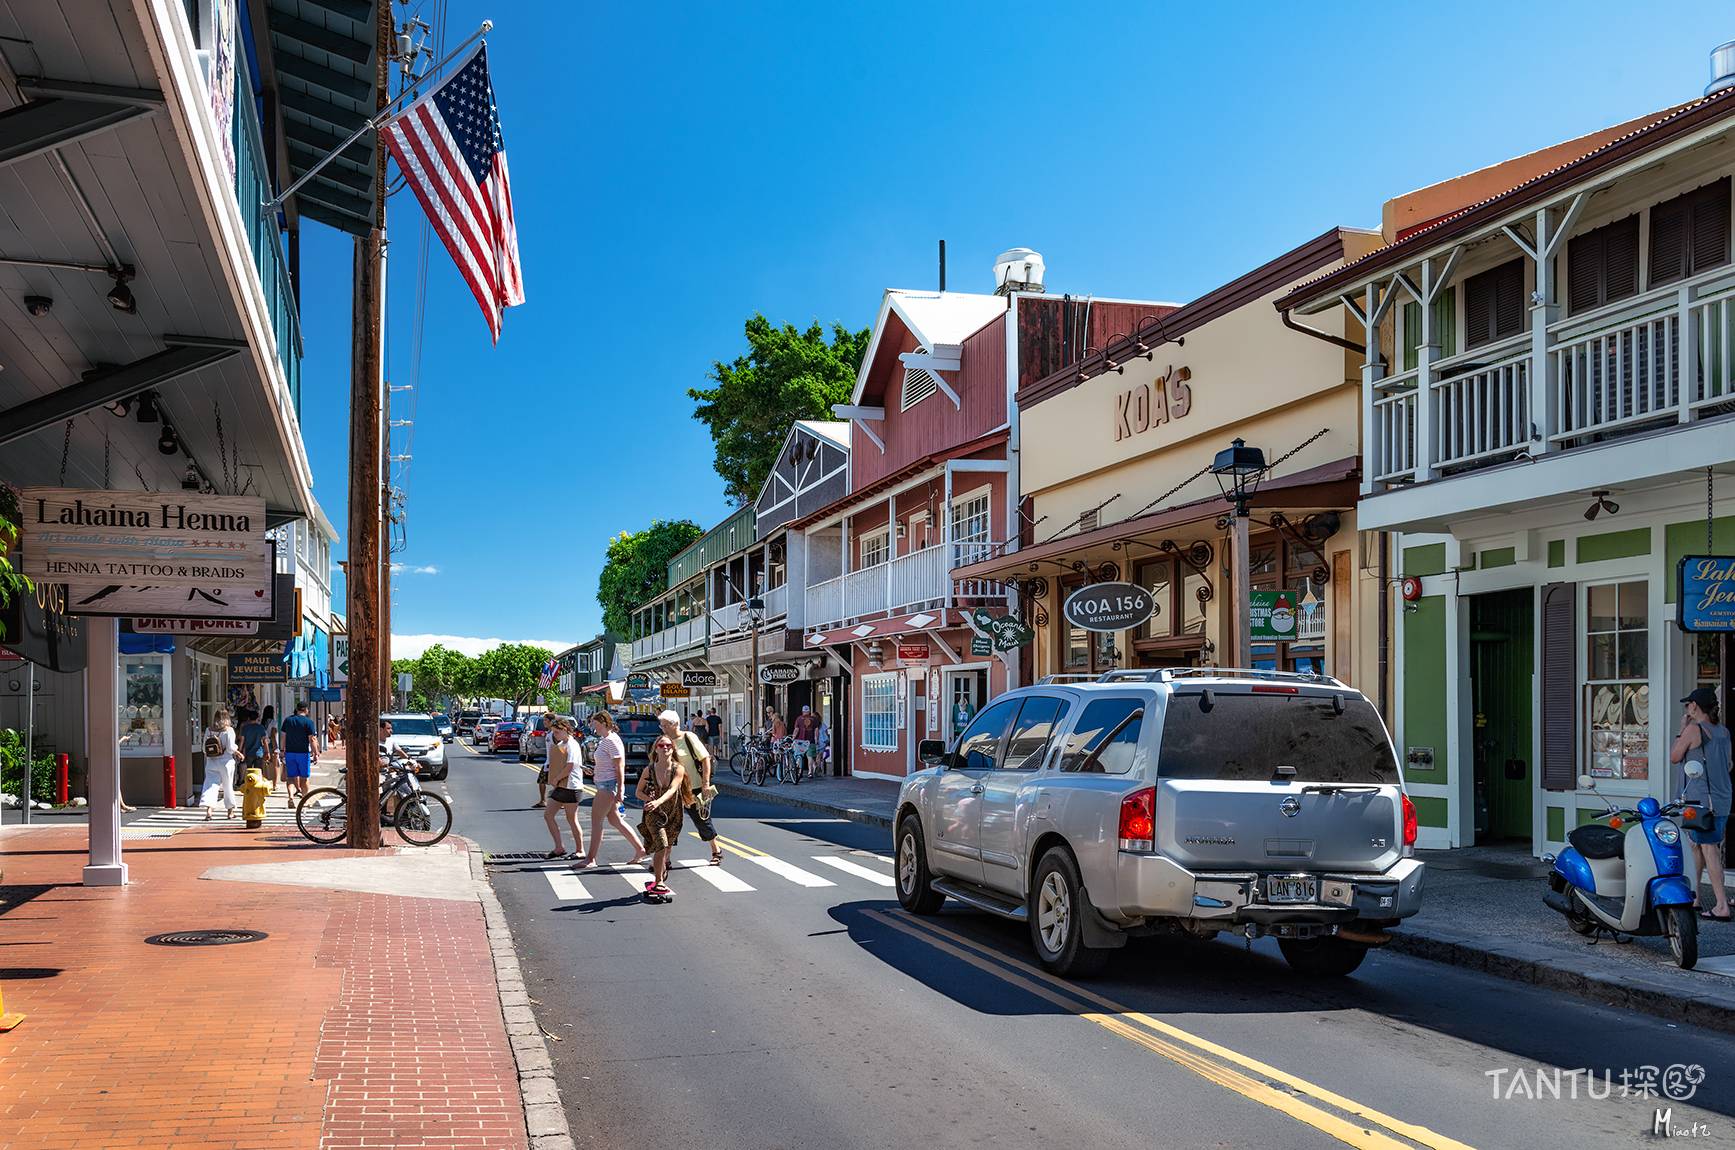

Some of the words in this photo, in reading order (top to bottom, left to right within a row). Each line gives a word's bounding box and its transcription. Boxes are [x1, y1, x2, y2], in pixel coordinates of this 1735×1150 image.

[1114, 365, 1192, 442] KOA'S
[36, 499, 150, 528] Lahaina
[160, 504, 250, 532] Henna
[46, 561, 101, 574] HENNA
[106, 563, 173, 577] TATTOO
[177, 564, 188, 577] &
[191, 567, 244, 579] BRAIDS
[1072, 598, 1112, 616] KOA
[137, 618, 188, 630] DIRTY
[190, 618, 252, 631] MONKEY
[1089, 613, 1134, 623] RESTAURANT
[244, 656, 271, 665] MAUI
[233, 665, 282, 674] JEWELERS
[684, 673, 715, 683] Adore
[1270, 881, 1289, 897] LAN
[1295, 881, 1315, 897] 816
